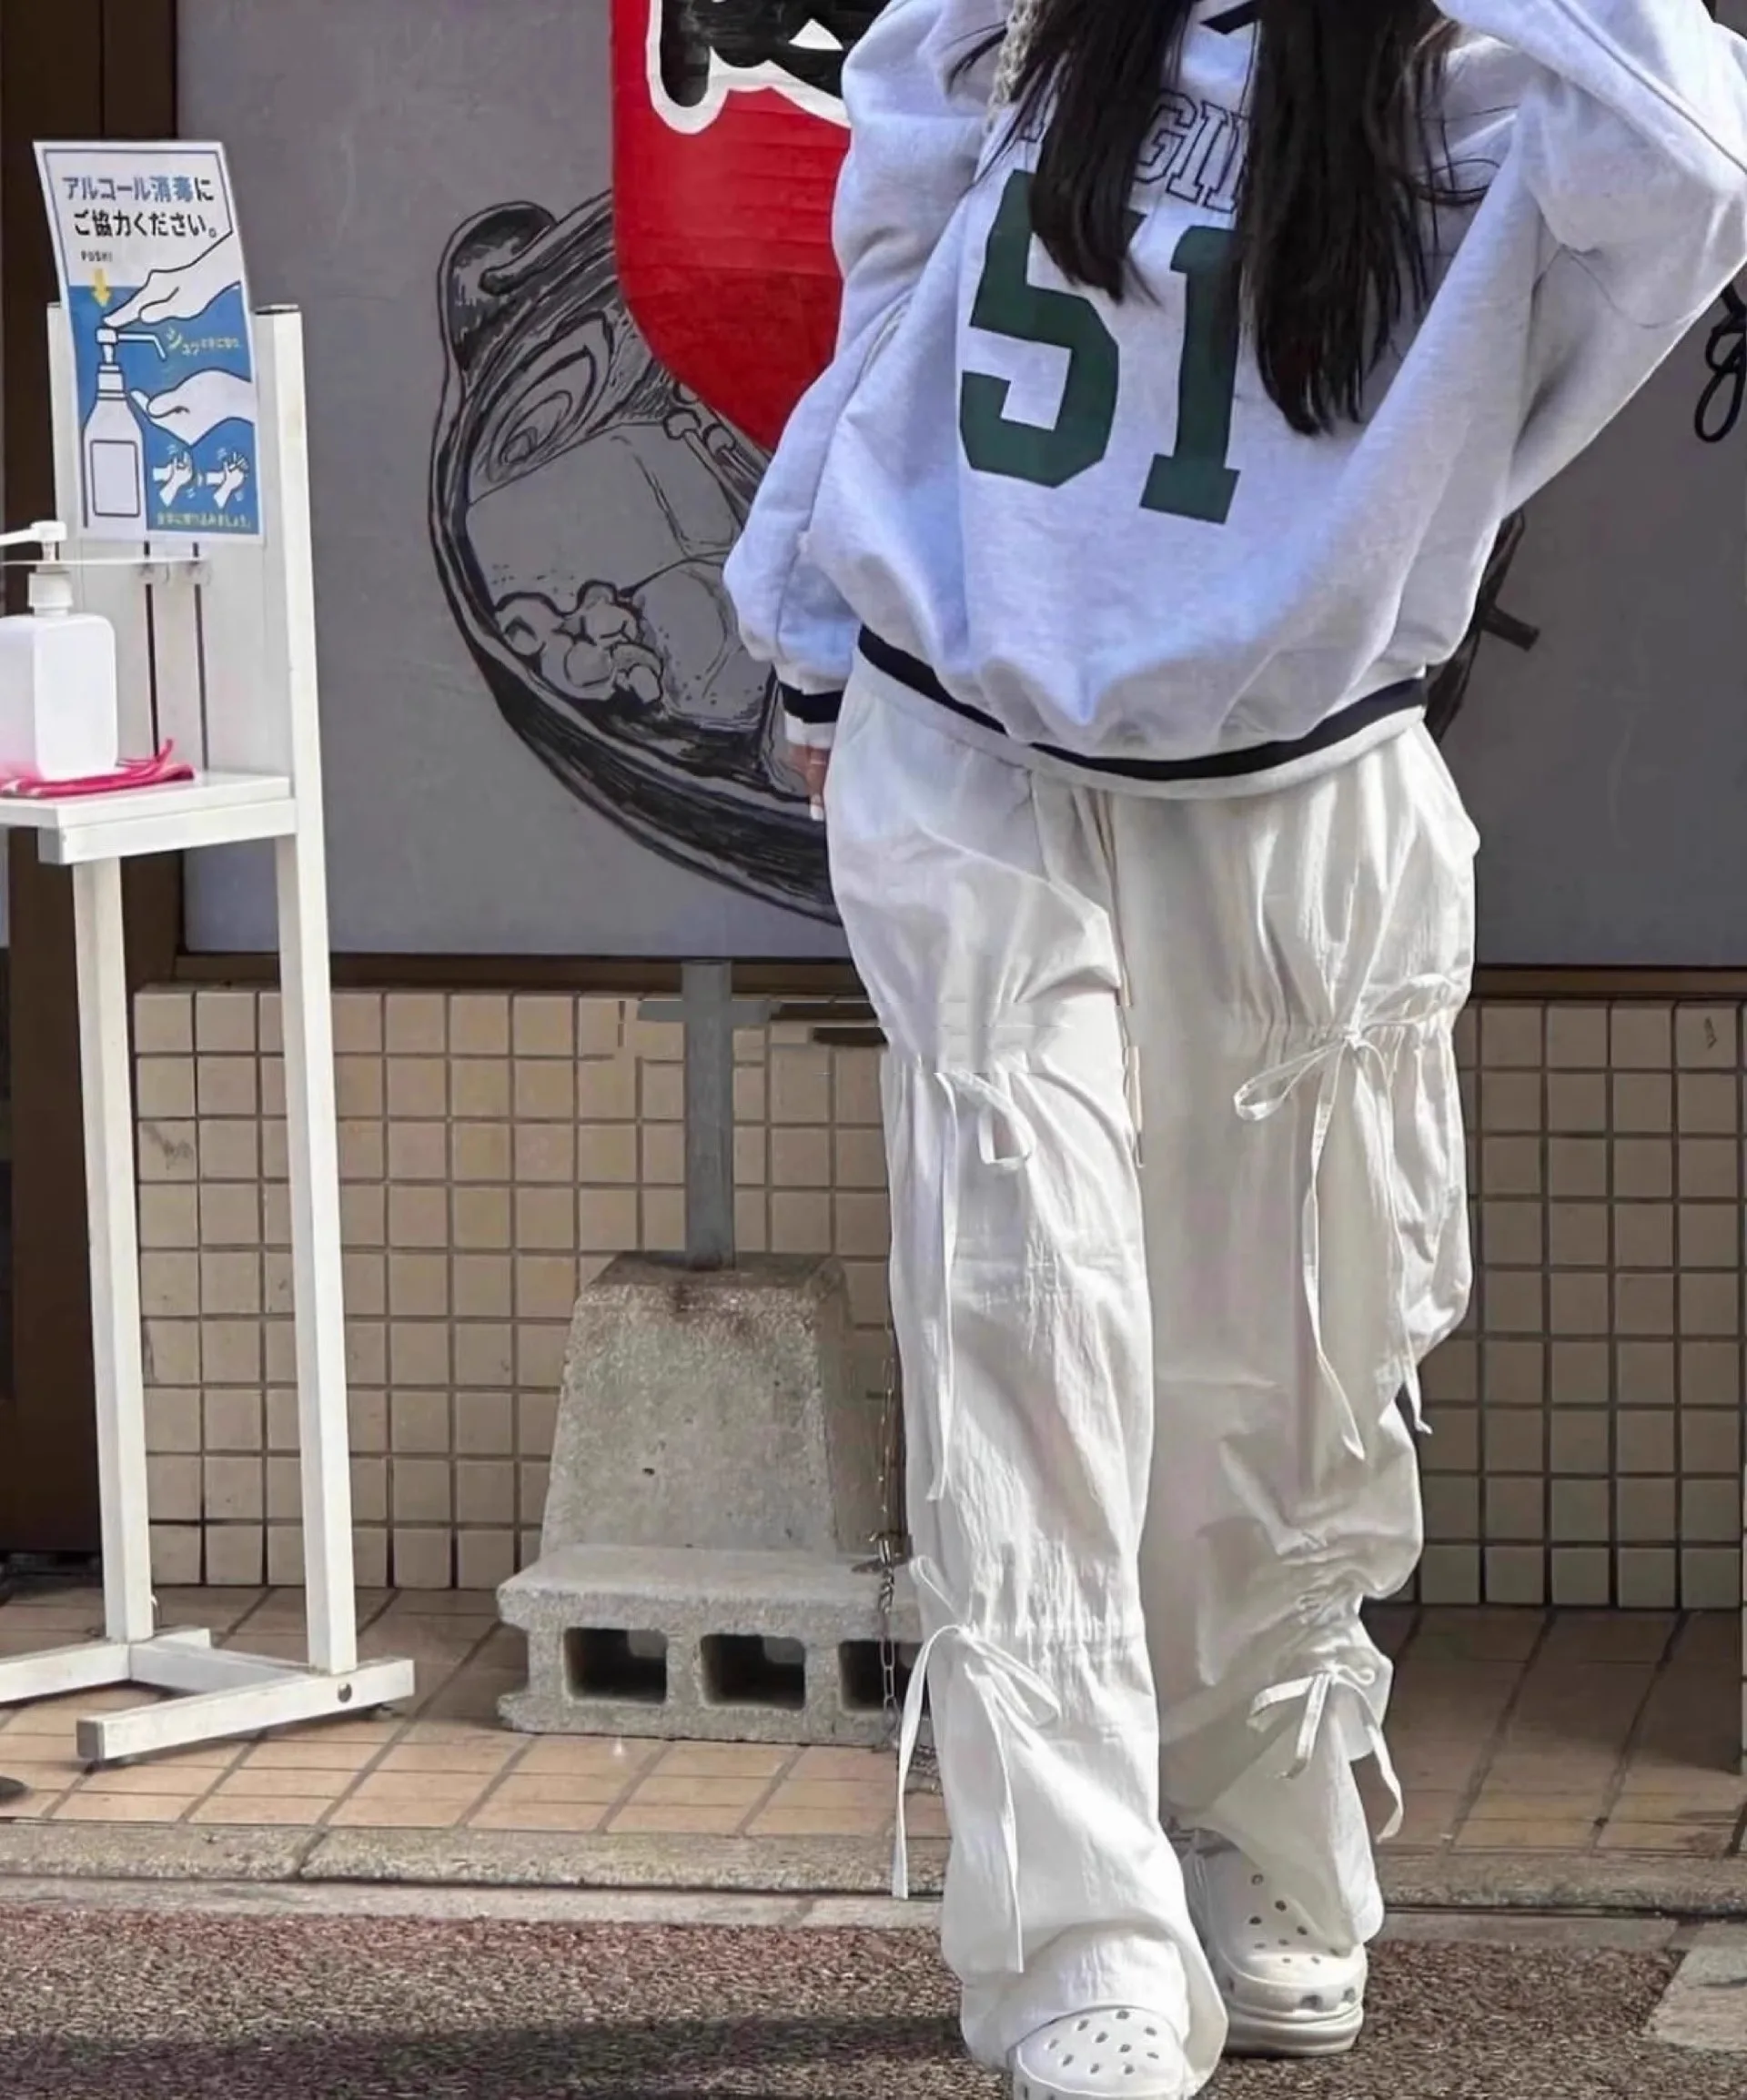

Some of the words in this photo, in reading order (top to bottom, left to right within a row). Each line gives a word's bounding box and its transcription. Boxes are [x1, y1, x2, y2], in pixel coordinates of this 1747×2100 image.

[62, 176, 214, 203] アルコール消毒に
[74, 208, 217, 238] ご協力ください。
[959, 169, 1240, 524] 51
